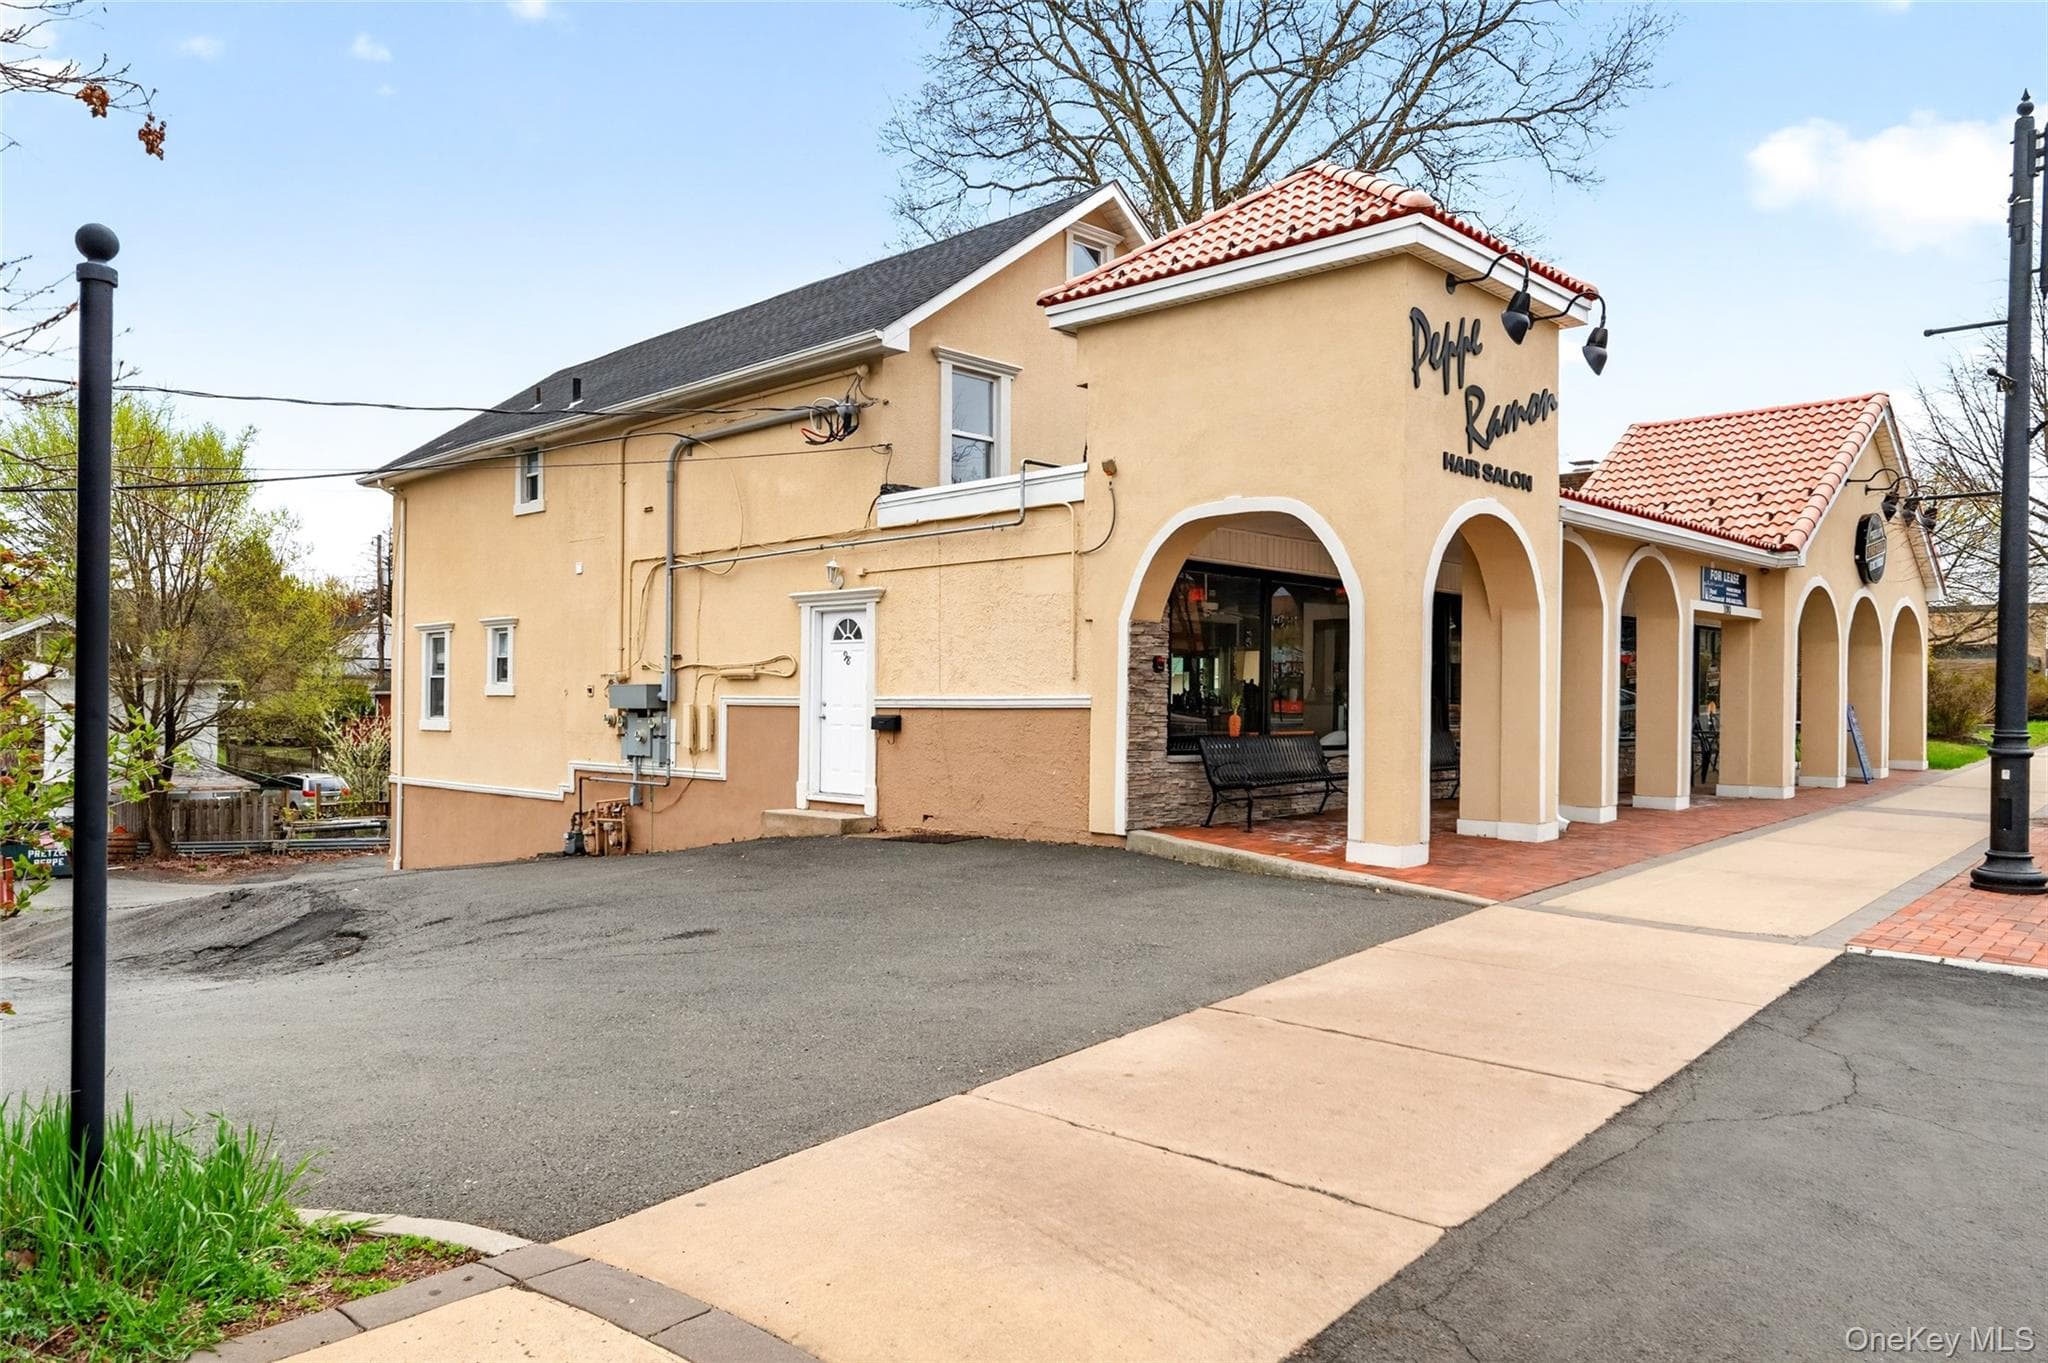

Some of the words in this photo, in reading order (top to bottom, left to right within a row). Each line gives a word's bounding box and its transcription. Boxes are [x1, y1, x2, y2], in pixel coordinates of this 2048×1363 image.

[1409, 306, 1483, 395] Peppe
[1464, 384, 1558, 454] Ramon
[1442, 451, 1480, 479] HAIR
[1481, 463, 1533, 492] SALON
[1710, 569, 1722, 581] FOR
[1723, 571, 1740, 584] LEASE
